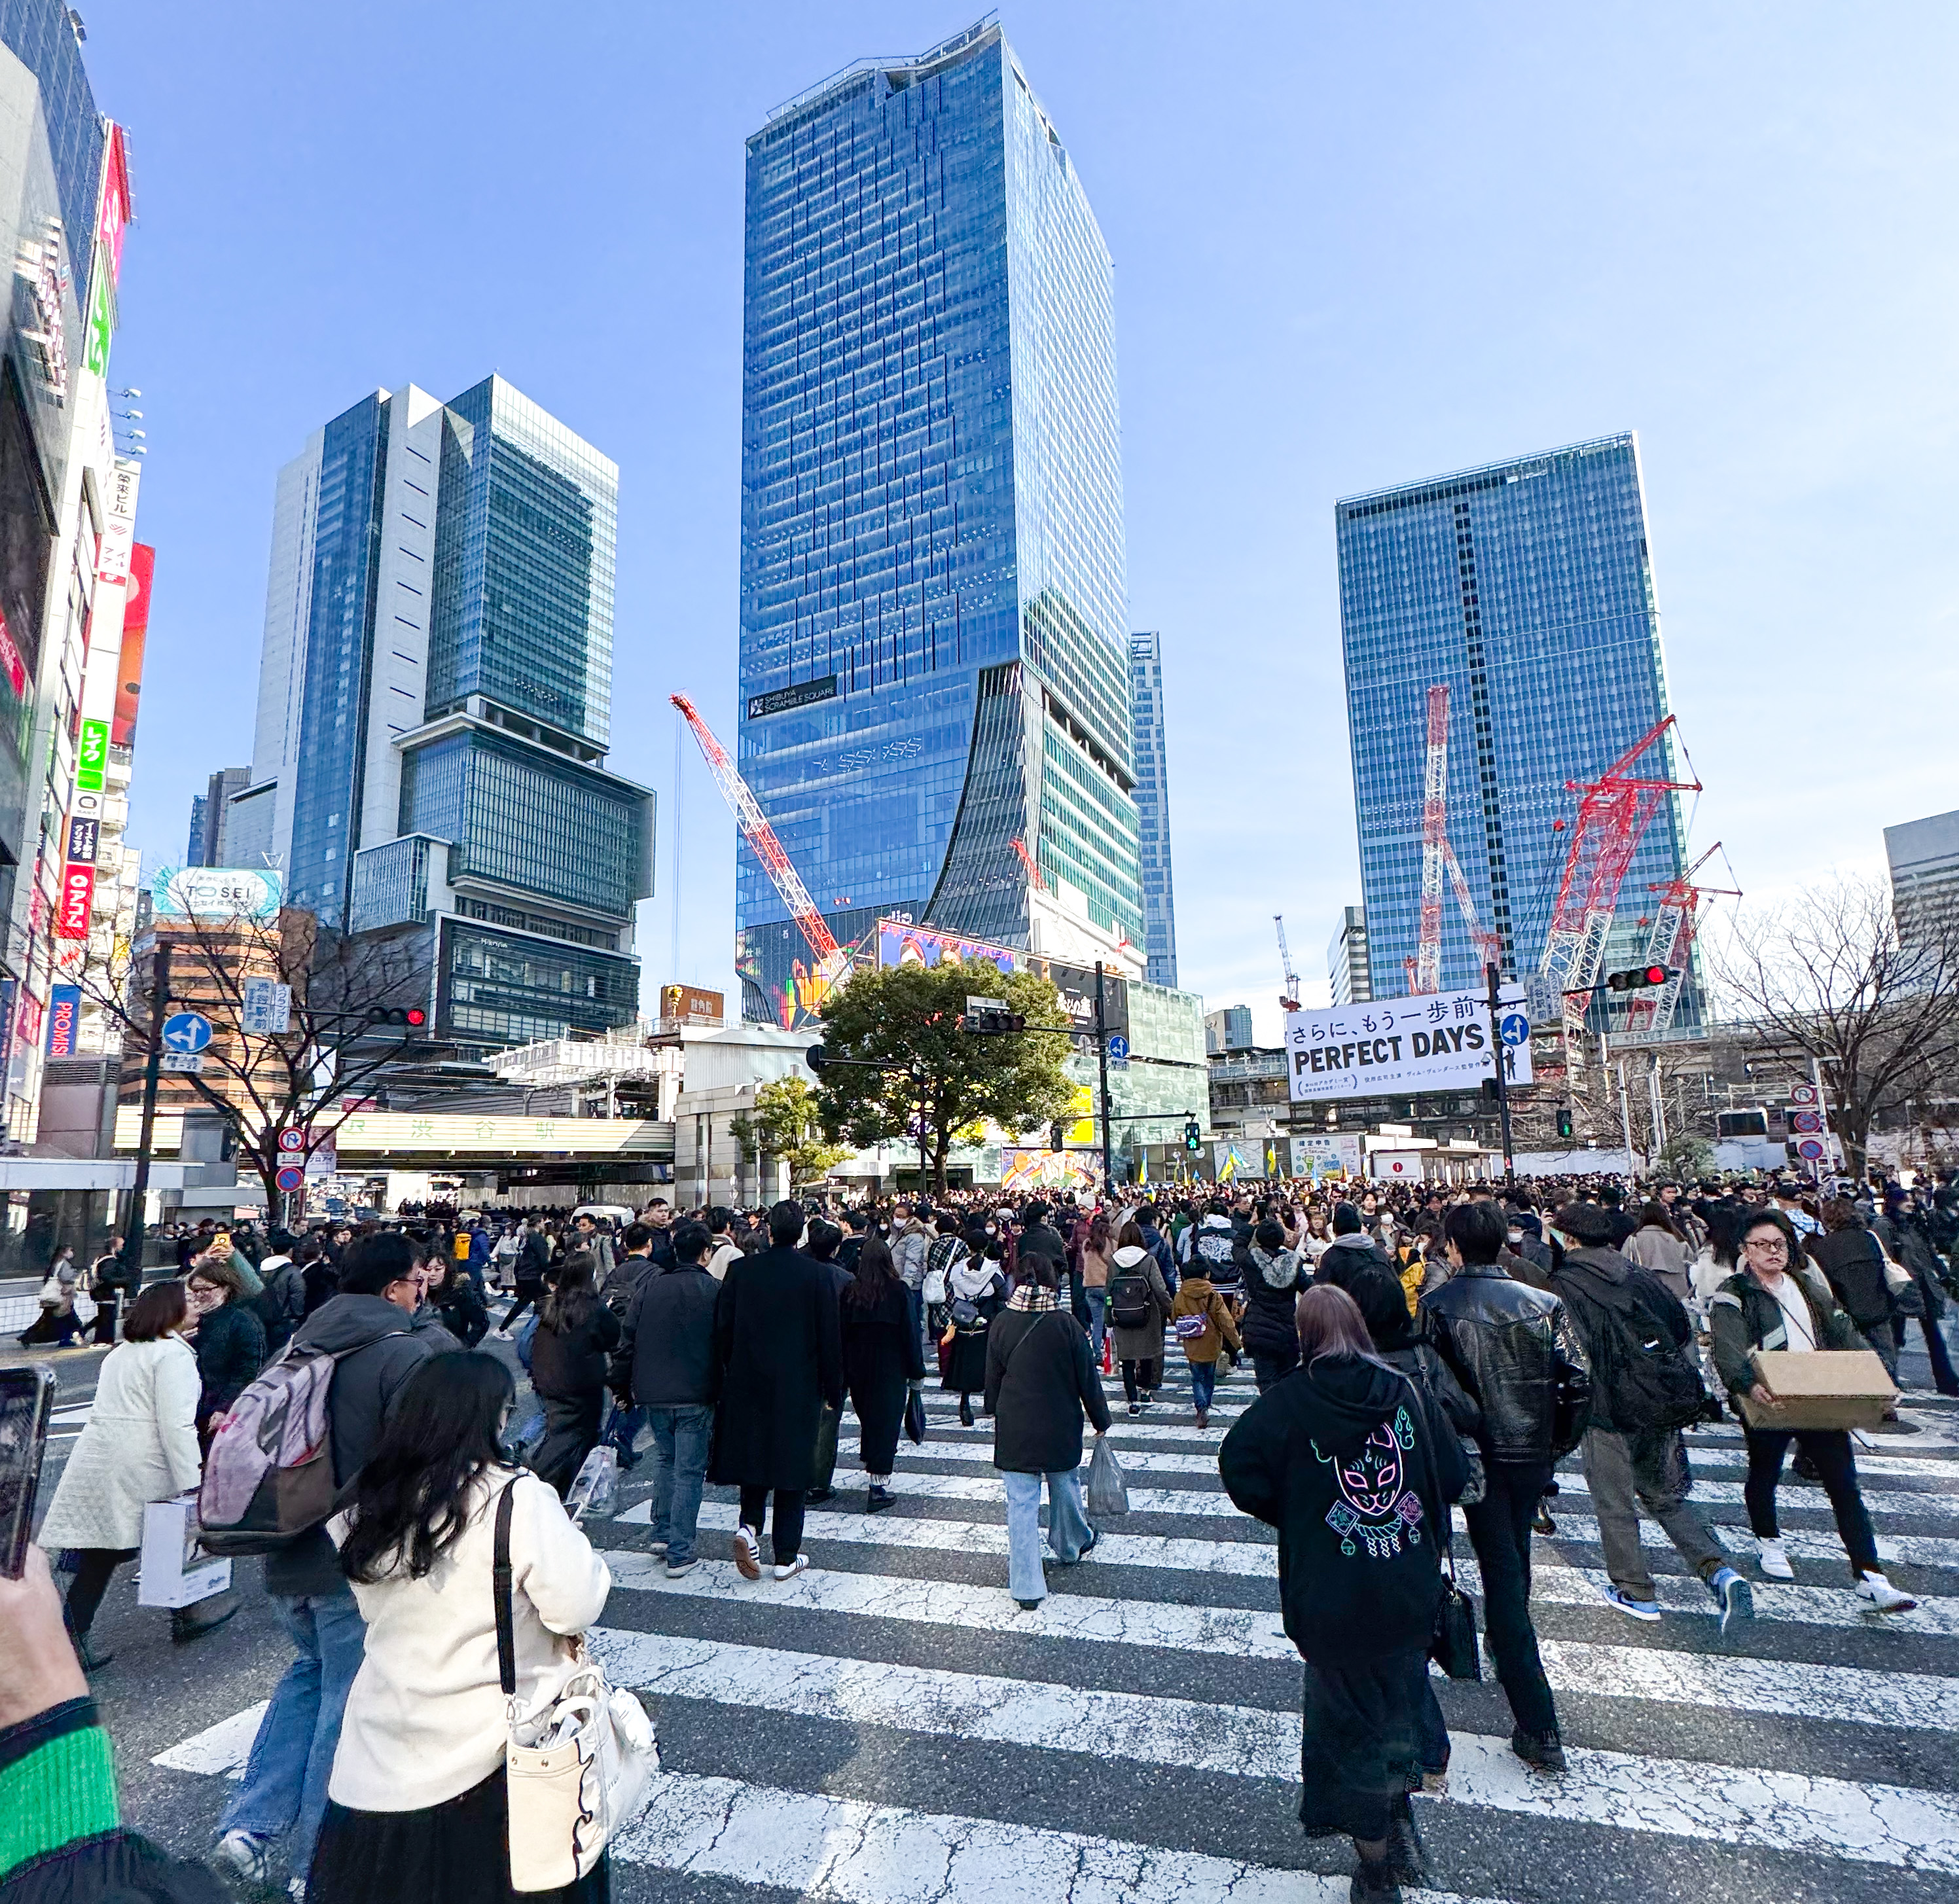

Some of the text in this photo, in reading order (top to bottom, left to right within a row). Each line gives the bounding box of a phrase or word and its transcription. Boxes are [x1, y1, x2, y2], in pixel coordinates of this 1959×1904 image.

[764, 689, 797, 704] SHIBUYA
[764, 685, 835, 711] SCRAMBLE SQUARE
[83, 727, 102, 762] レイク
[66, 889, 86, 928] アコム
[1534, 977, 1546, 1020] 渋谷駅前
[51, 1002, 73, 1056] PROMIS
[1294, 1023, 1484, 1075] PERFECT DAYS
